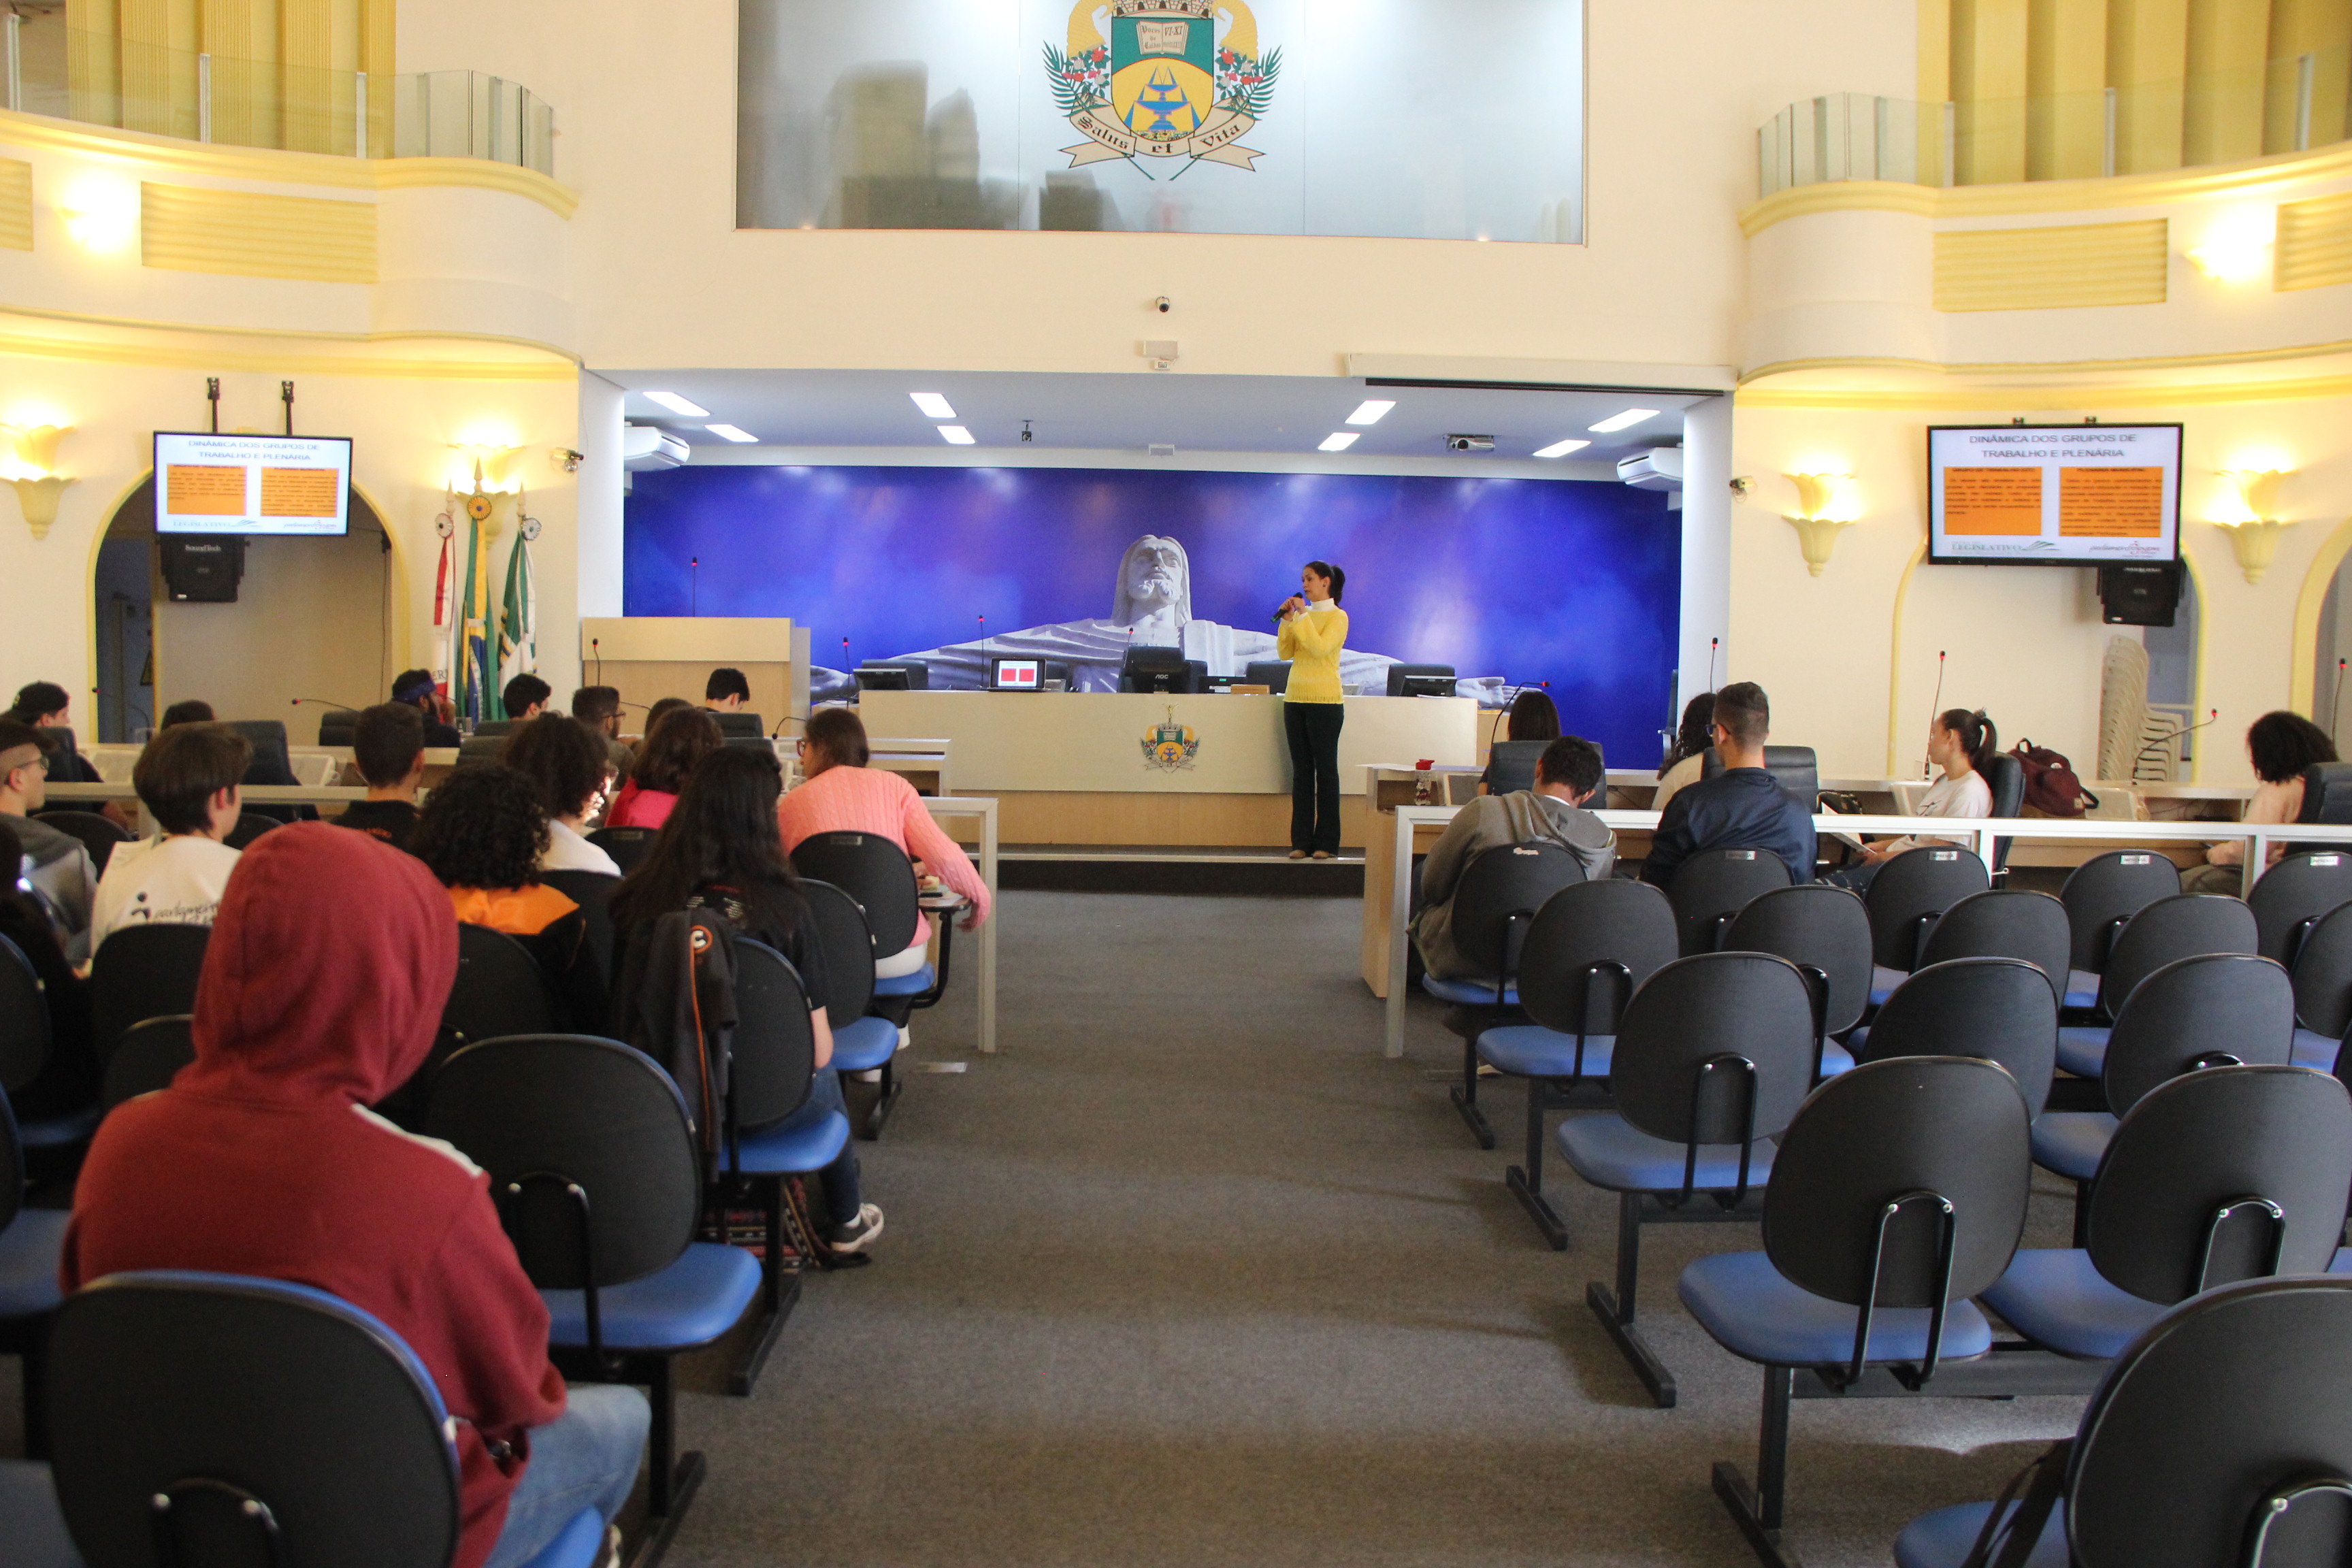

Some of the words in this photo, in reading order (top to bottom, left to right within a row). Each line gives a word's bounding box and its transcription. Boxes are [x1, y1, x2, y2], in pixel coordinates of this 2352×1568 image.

[1077, 116, 1128, 150] Salus
[1152, 144, 1173, 154] et
[1200, 124, 1241, 148] Vita
[1969, 434, 2029, 443] DINÂMICA
[2031, 435, 2058, 443] DOS
[2061, 434, 2116, 442] GRUPOS
[2119, 434, 2137, 442] DE
[1982, 449, 2046, 457] TRABALHO
[2050, 449, 2059, 457] E
[2061, 448, 2124, 457] PLENÁRIA
